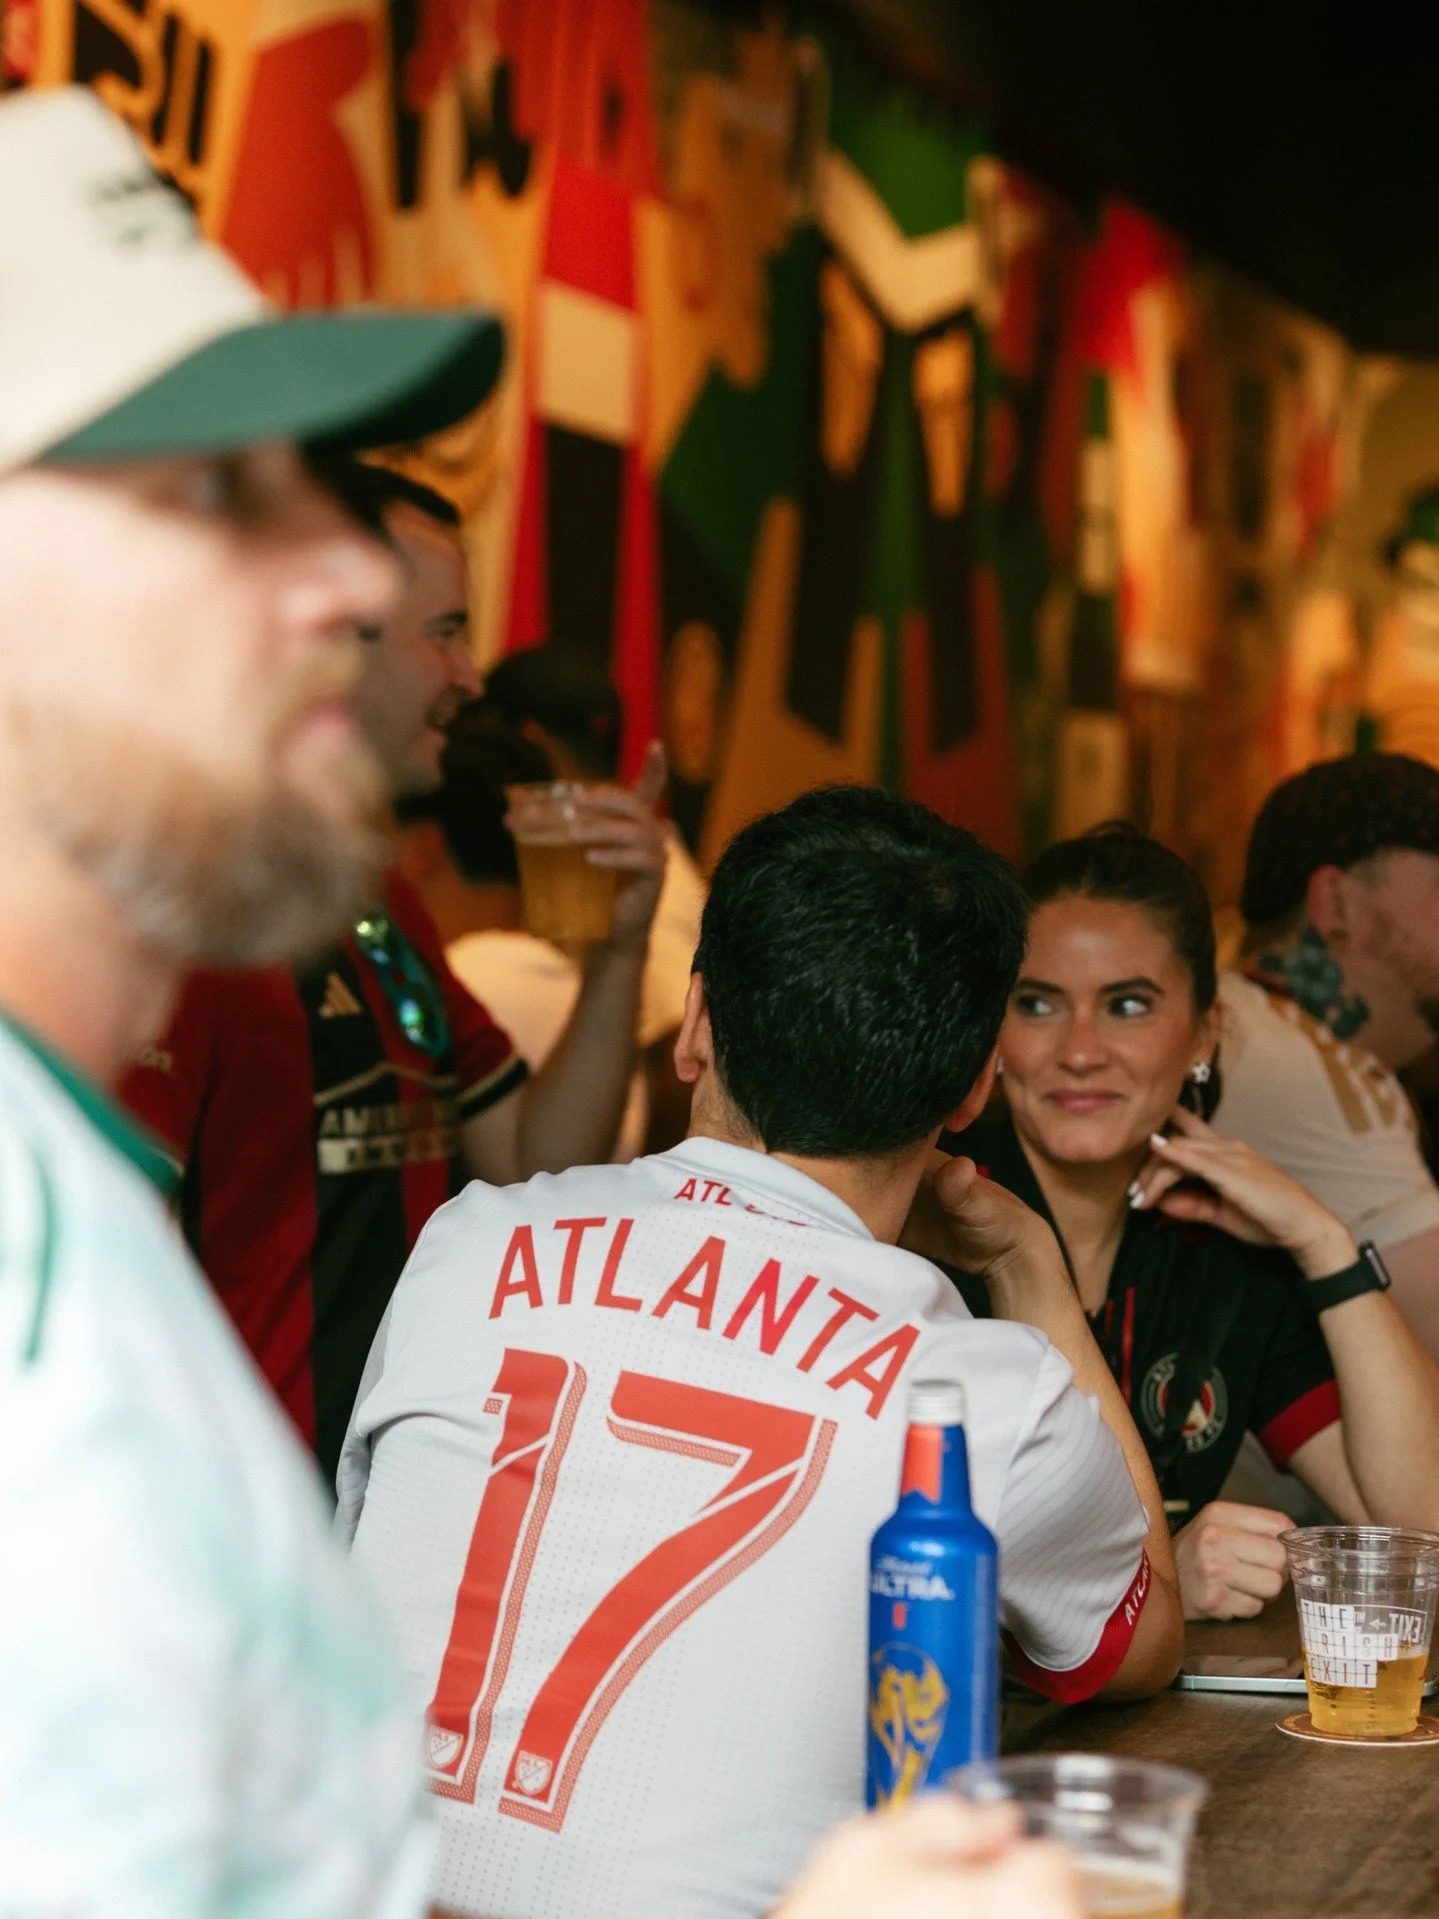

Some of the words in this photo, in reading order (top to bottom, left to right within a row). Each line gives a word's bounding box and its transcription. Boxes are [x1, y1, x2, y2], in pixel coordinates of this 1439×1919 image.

[488, 1216, 921, 1421] ATLANTA
[422, 1347, 838, 1833] 17
[1303, 1602, 1348, 1630] THE
[1307, 1630, 1393, 1658] IRISH
[1310, 1657, 1371, 1685] EXIT
